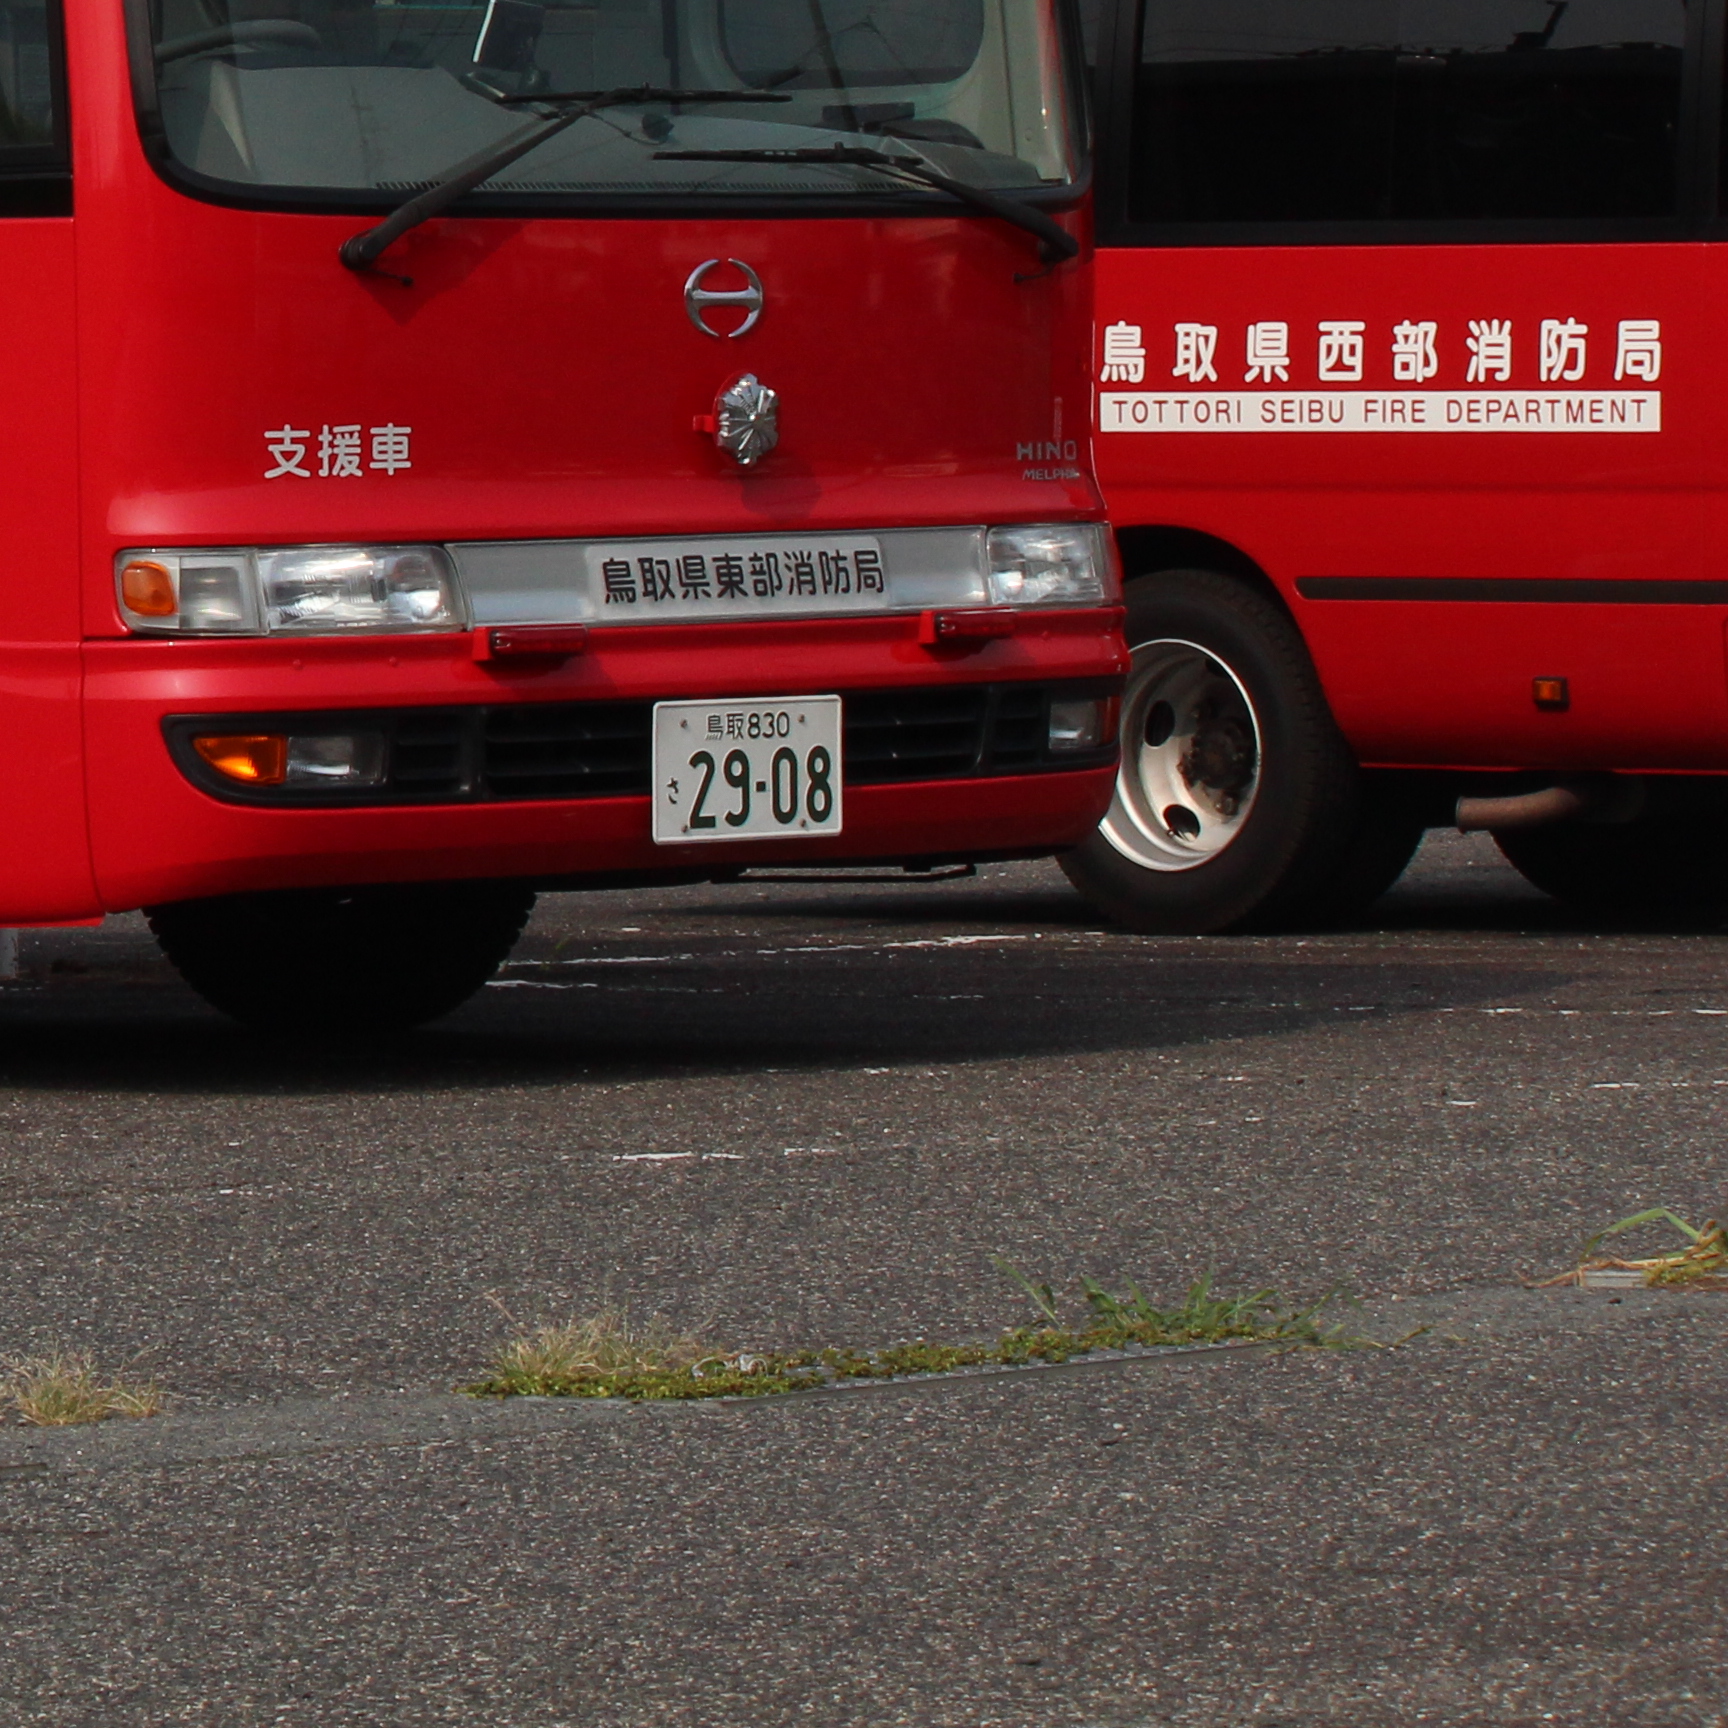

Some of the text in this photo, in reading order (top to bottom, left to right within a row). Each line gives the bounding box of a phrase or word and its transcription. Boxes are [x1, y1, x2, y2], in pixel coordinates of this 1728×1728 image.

[1099, 317, 1662, 385] 鳥取県西部消防局
[1112, 398, 1648, 424] TOTTORI SEIBU FIRE DEPARTMENT
[263, 422, 413, 479] 支援車
[1015, 439, 1078, 461] HINO
[601, 548, 886, 605] 鳥取県東部消防局
[687, 744, 834, 830] 29-08
